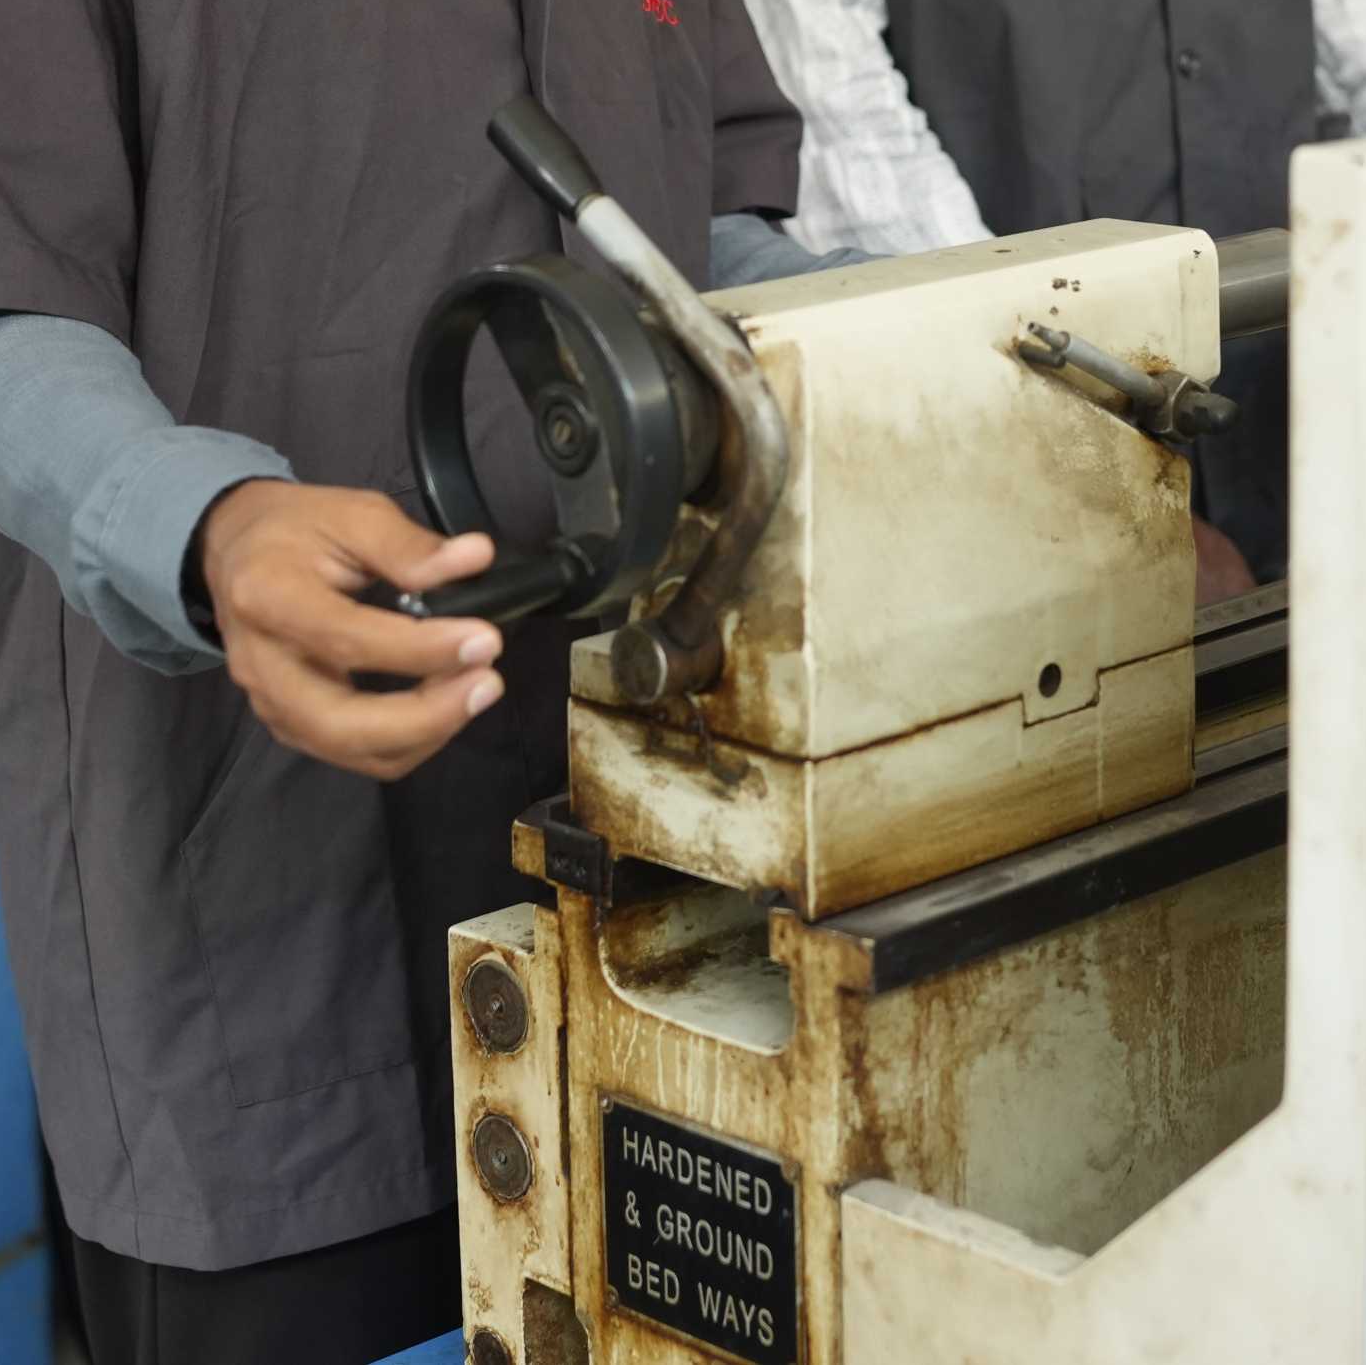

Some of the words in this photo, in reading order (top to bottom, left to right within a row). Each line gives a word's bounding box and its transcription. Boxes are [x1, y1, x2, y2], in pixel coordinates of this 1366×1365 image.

[622, 1126, 772, 1217] HARDENED
[624, 1190, 641, 1228] &
[656, 1204, 773, 1281] GROUND
[627, 1253, 680, 1306] BED
[697, 1282, 774, 1348] WAYS
